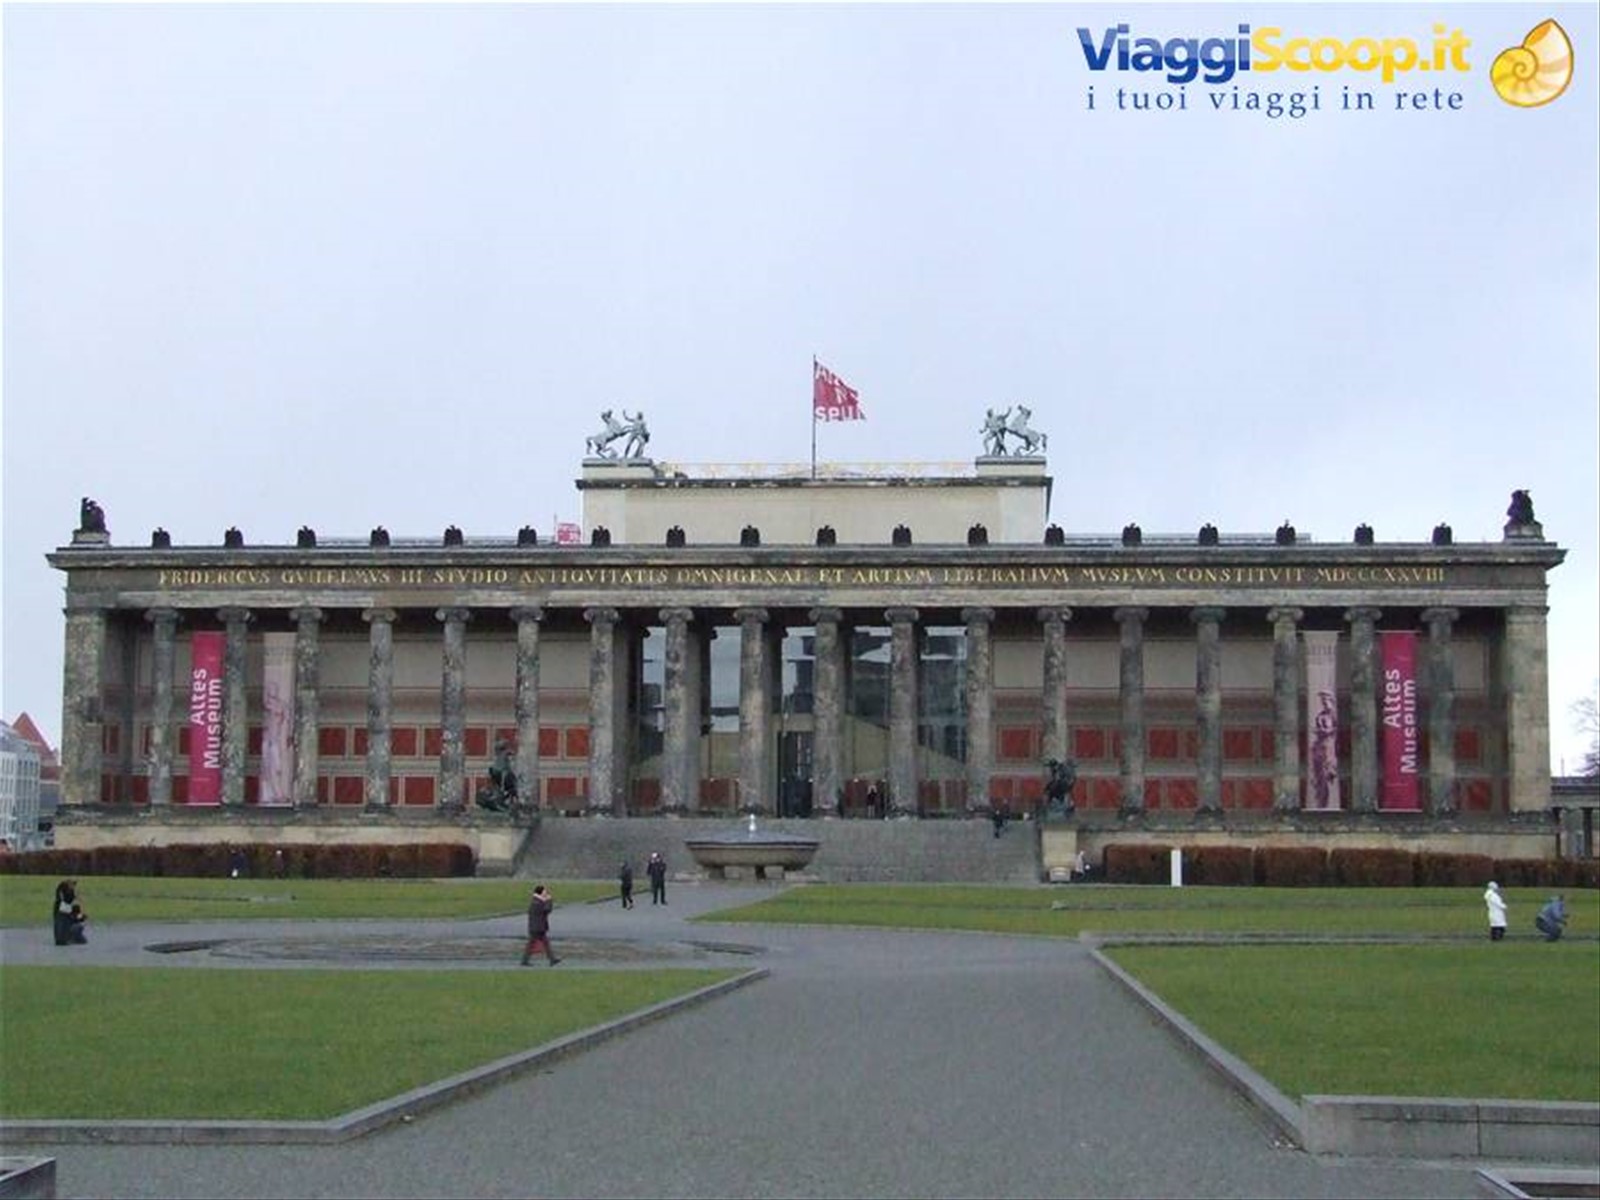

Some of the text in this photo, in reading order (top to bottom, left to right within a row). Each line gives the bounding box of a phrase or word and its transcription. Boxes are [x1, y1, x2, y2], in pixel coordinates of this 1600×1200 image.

[433, 568, 509, 584] STVDIO
[819, 567, 845, 583] ET
[851, 567, 933, 583] ARTIVM
[190, 668, 206, 726] Altes
[203, 679, 221, 768] Museum
[1383, 668, 1401, 728] Altes
[1400, 680, 1417, 773] Museum
